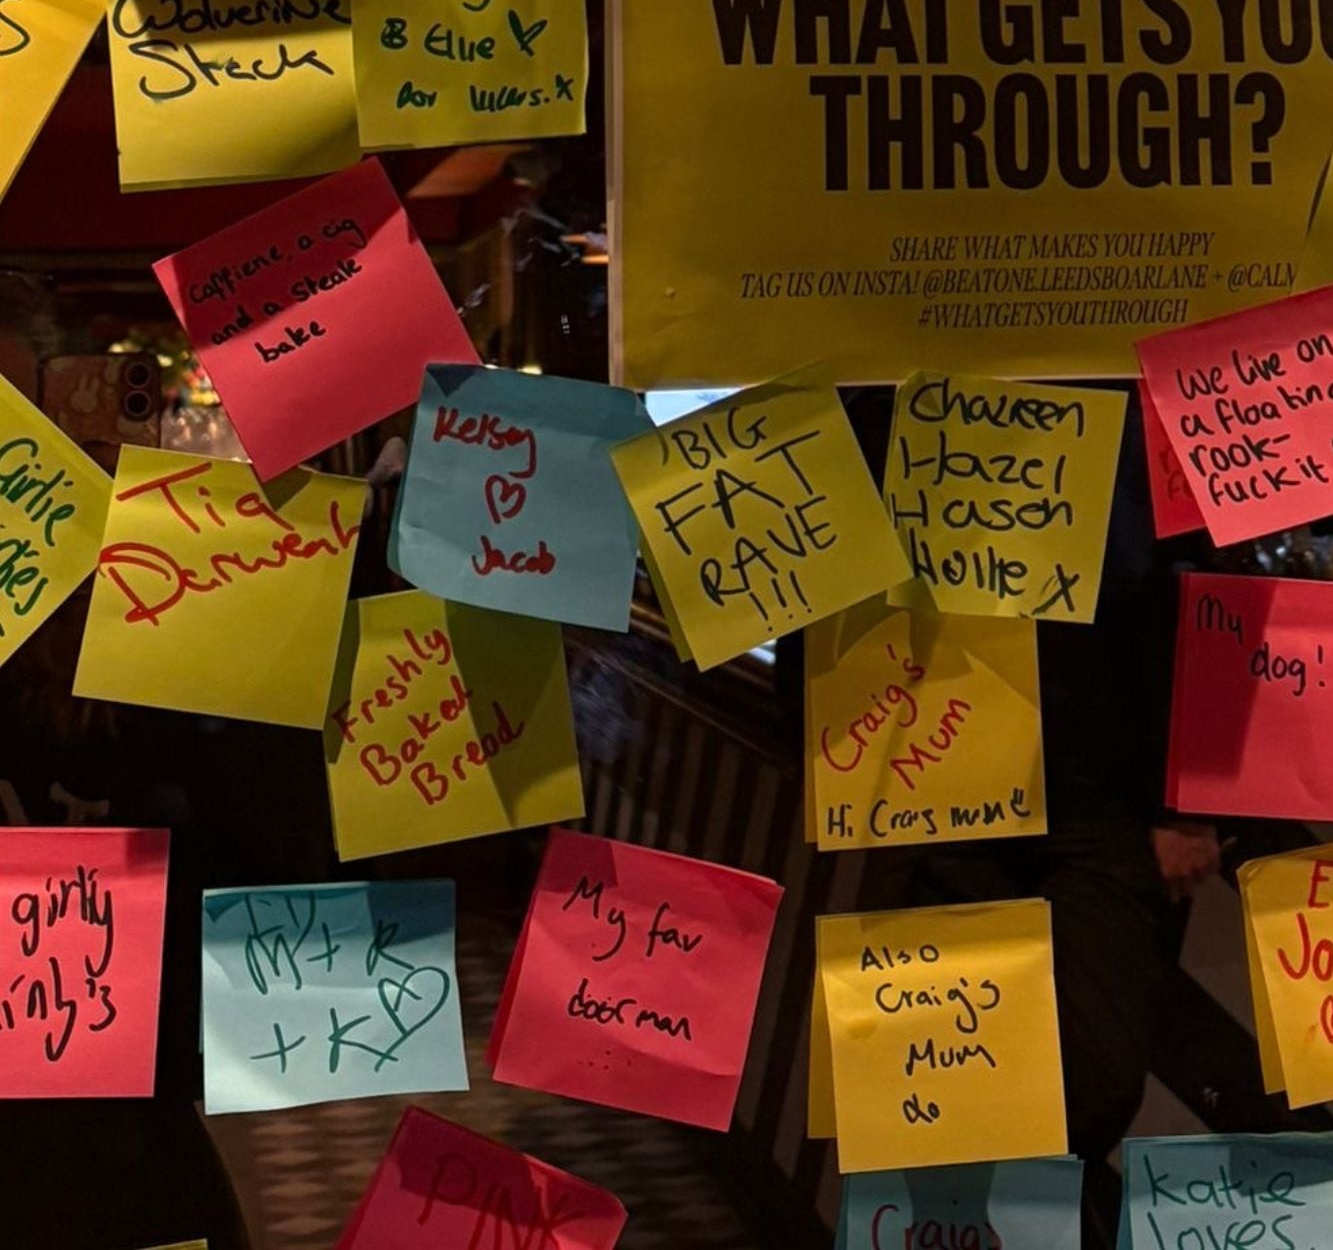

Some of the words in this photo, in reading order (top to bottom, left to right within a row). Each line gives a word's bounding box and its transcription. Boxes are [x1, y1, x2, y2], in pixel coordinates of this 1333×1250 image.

[810, 72, 1287, 191] THROUGH?
[296, 233, 315, 251] a
[890, 235, 957, 264] SHARE
[963, 234, 1026, 262] WHAT
[1030, 232, 1099, 261] MAKES
[1102, 232, 1149, 259] YOU
[1149, 230, 1216, 259] HAPPY
[740, 273, 783, 299] TAG
[785, 272, 817, 297] US
[817, 271, 853, 297] ON
[853, 269, 921, 297] INSTA!
[210, 305, 256, 346] and
[262, 299, 282, 317] a
[917, 298, 1189, 329] #WHATGETSYOUTHROUGH
[254, 320, 328, 364] bake
[1176, 365, 1229, 401] We
[1231, 349, 1286, 386] live
[672, 405, 769, 472] BIG
[1180, 414, 1214, 438] a
[899, 430, 1068, 495] Hazel
[1207, 466, 1301, 507] fuck
[1294, 454, 1330, 484] it
[116, 461, 296, 535] Tia
[655, 429, 822, 557] FAT
[470, 535, 558, 578] Jacob
[700, 495, 838, 608] RAVE
[1195, 592, 1244, 644] My
[331, 628, 453, 746] Freshly
[1250, 644, 1328, 697] dog!
[360, 674, 473, 789] Baked
[820, 642, 926, 772] Craig's
[410, 702, 525, 808] Bread
[889, 697, 973, 791] Mum
[11, 864, 115, 979] girly
[562, 875, 627, 962] My
[646, 901, 704, 959] fav
[860, 944, 940, 973] Also
[876, 977, 1001, 1035] Craig's
[905, 1038, 997, 1078] Mum
